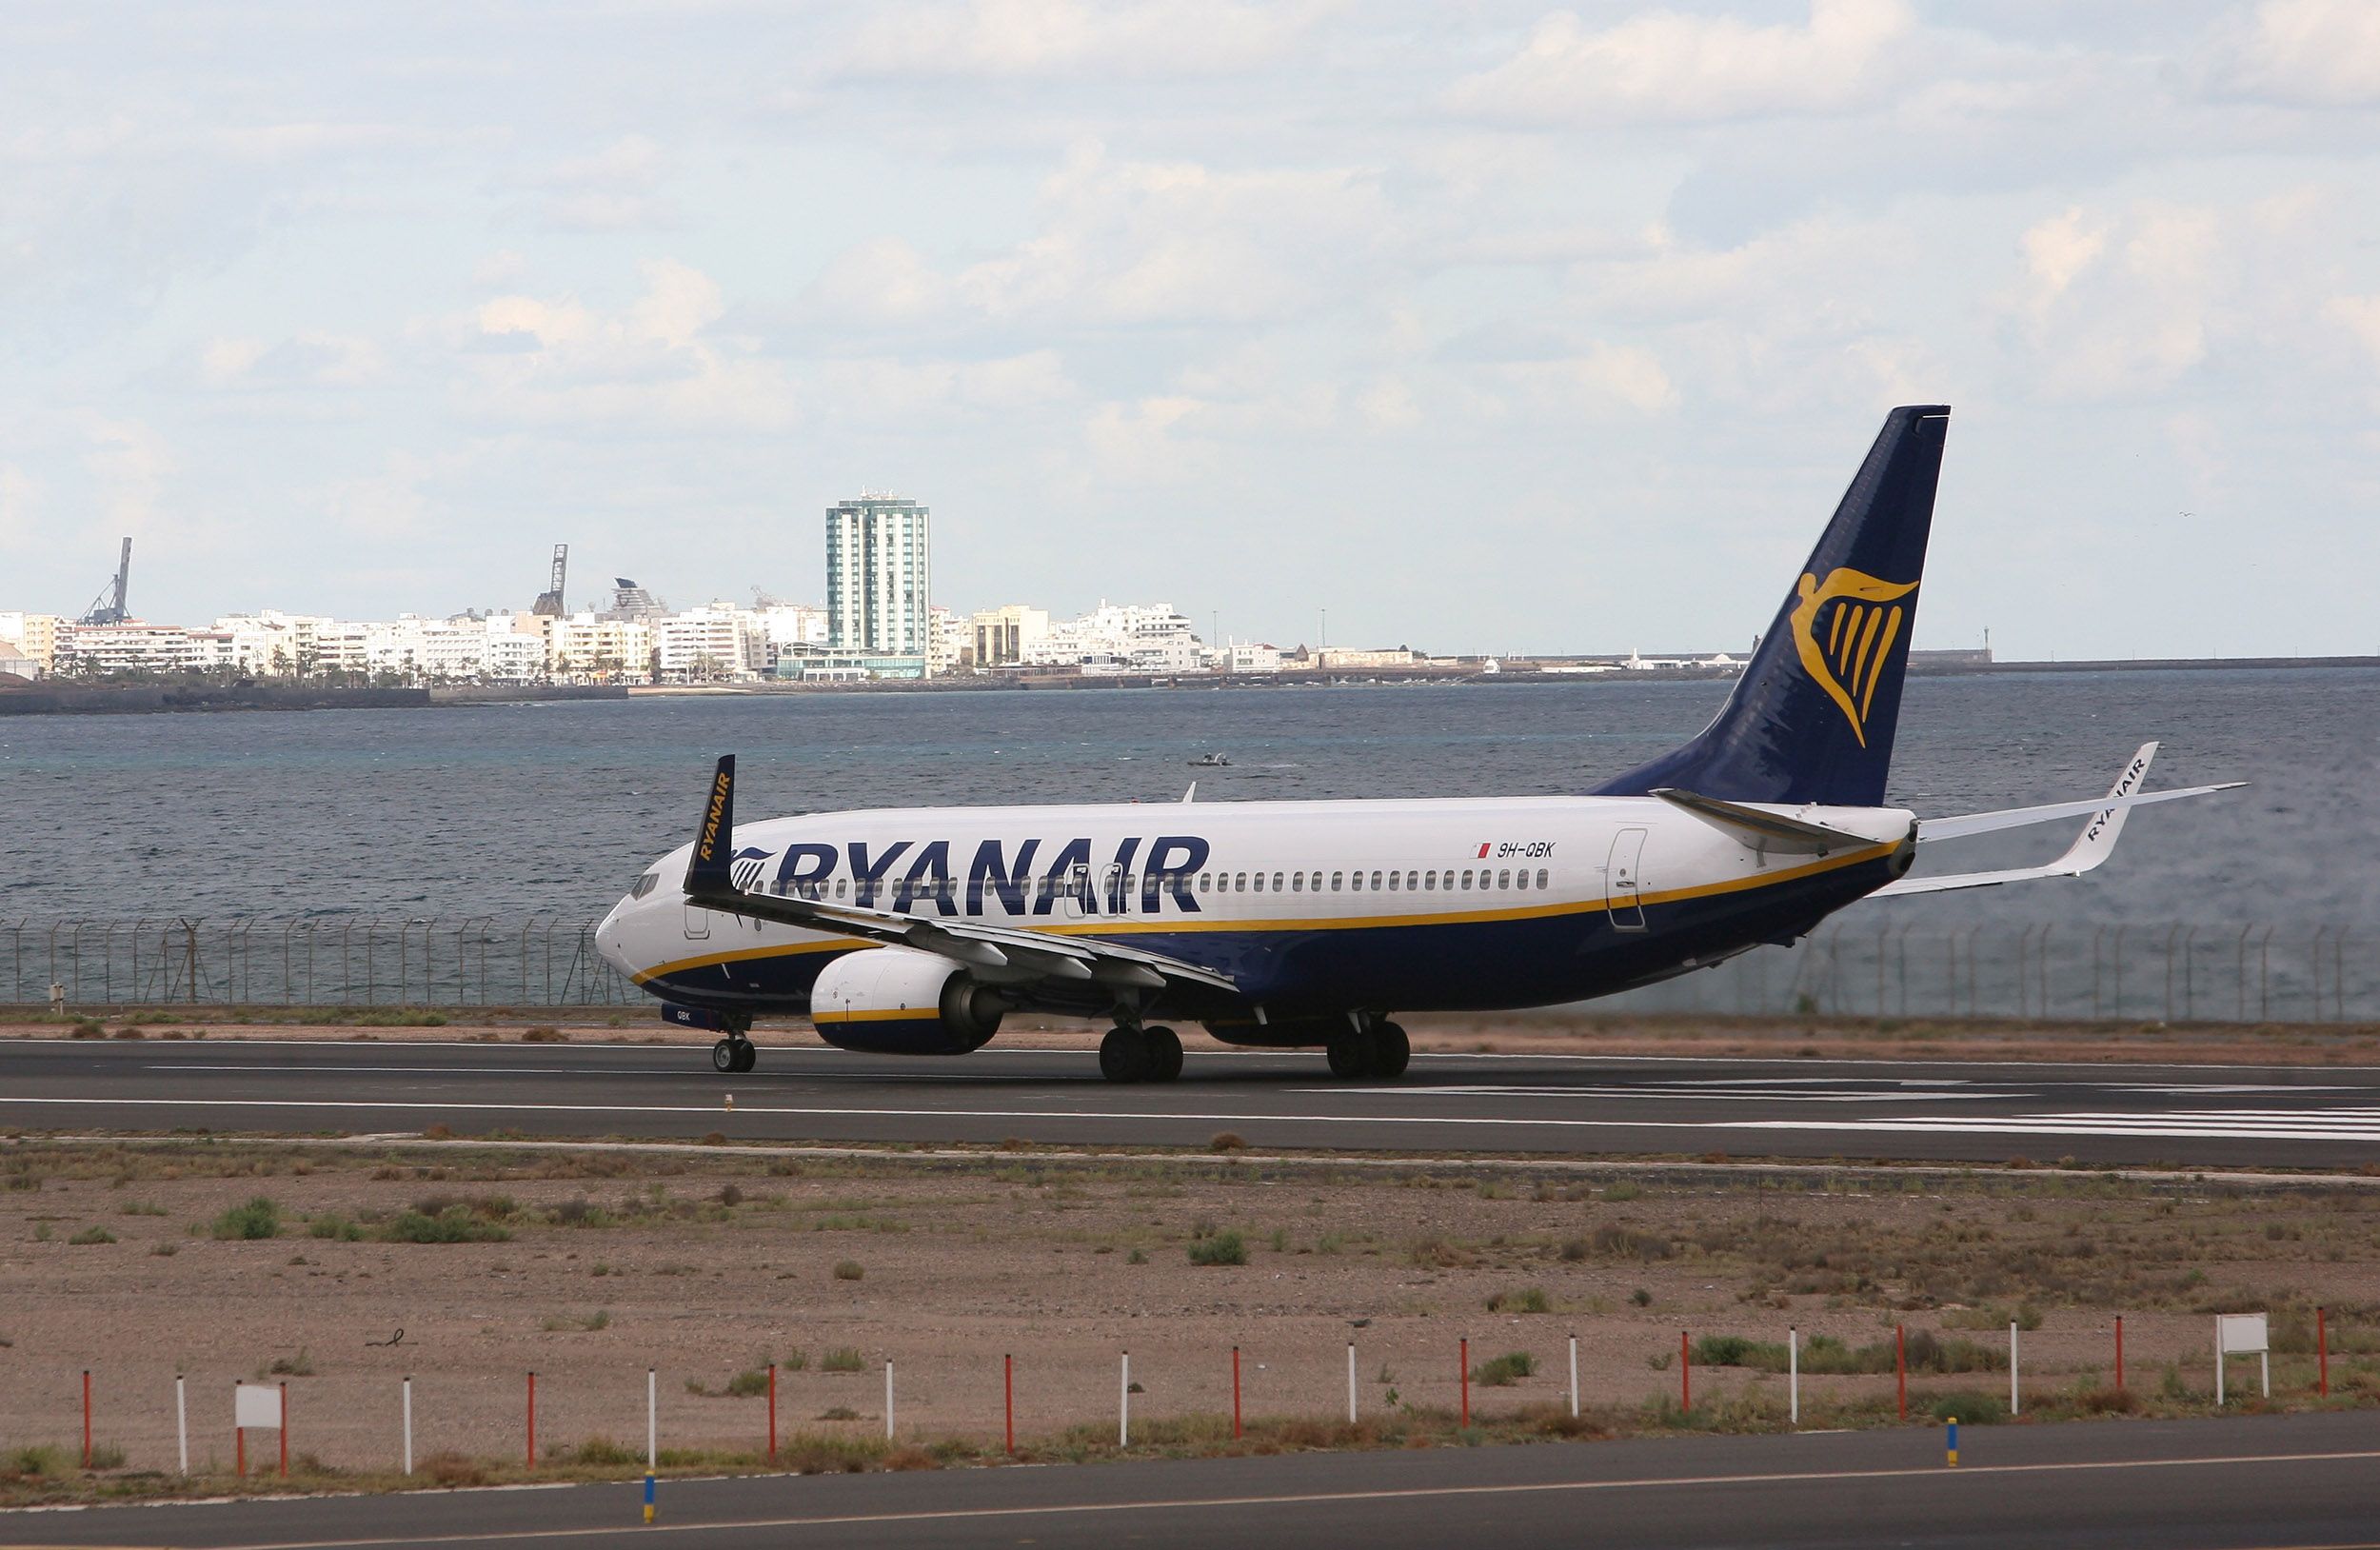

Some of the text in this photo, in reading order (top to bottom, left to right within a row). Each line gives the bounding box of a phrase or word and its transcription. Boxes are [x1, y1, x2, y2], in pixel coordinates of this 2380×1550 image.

[700, 771, 731, 862] RYANAIR
[1497, 842, 1557, 859] 9H-QBK
[775, 835, 1211, 916] RYANAIR
